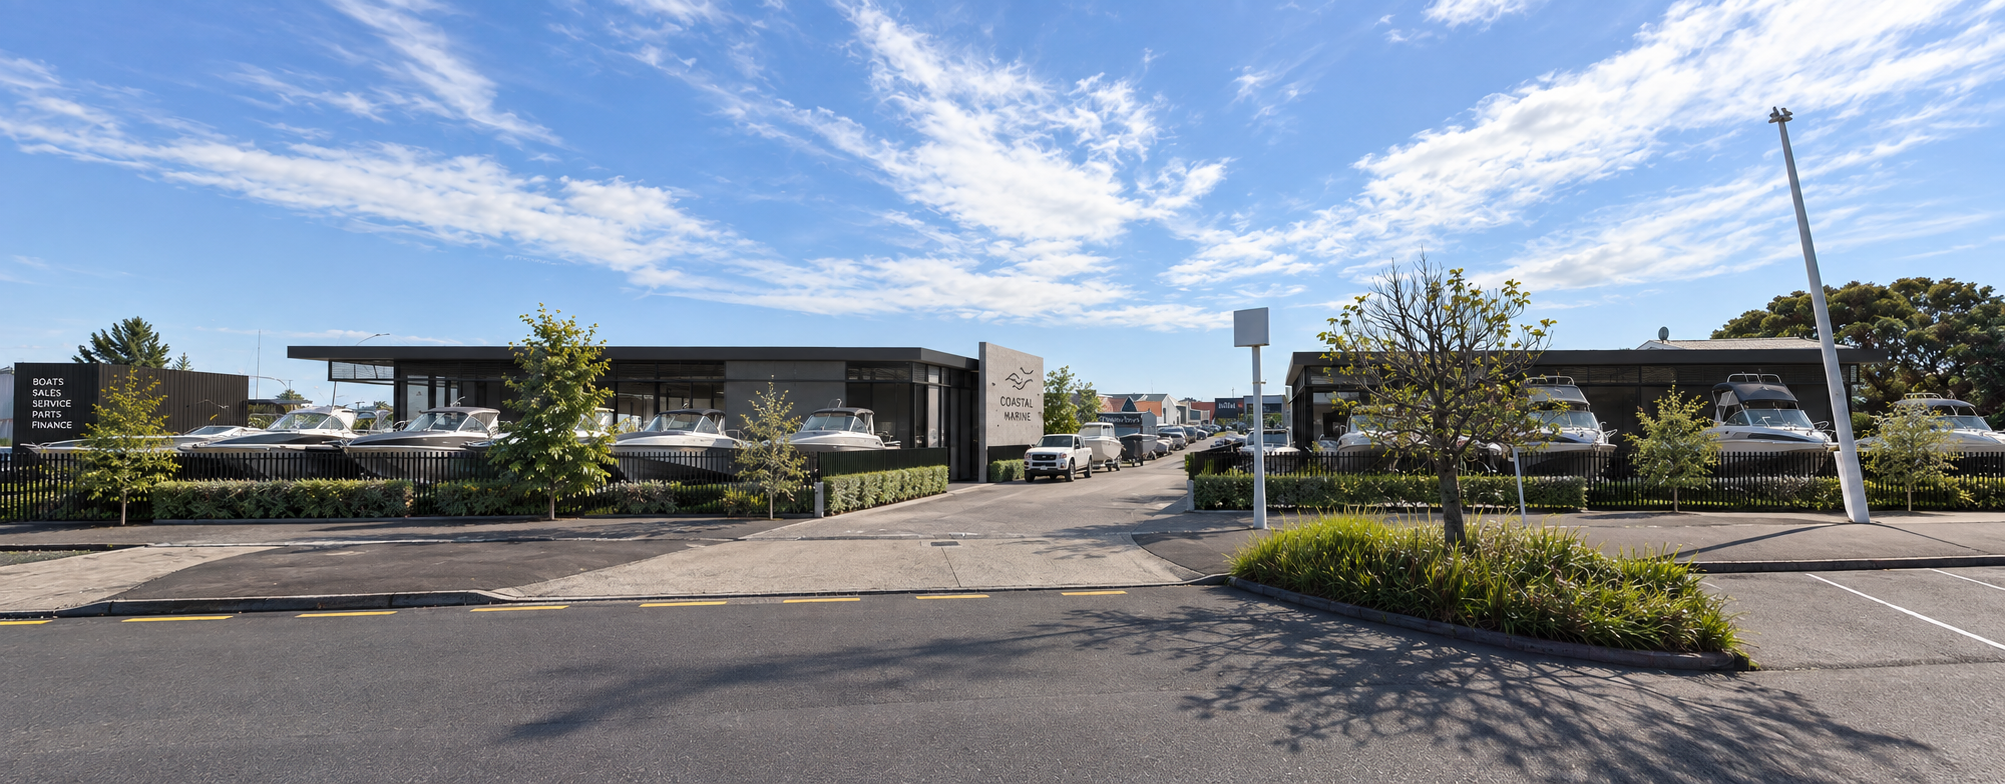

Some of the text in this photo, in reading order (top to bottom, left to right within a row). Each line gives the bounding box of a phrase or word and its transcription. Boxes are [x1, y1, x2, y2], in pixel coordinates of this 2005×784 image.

[32, 378, 64, 386] BOATS
[32, 389, 61, 397] SALES
[32, 399, 72, 408] SERVICE
[1000, 395, 1033, 408] COASTAL
[32, 410, 62, 418] PARTS
[32, 421, 72, 429] FINANCE
